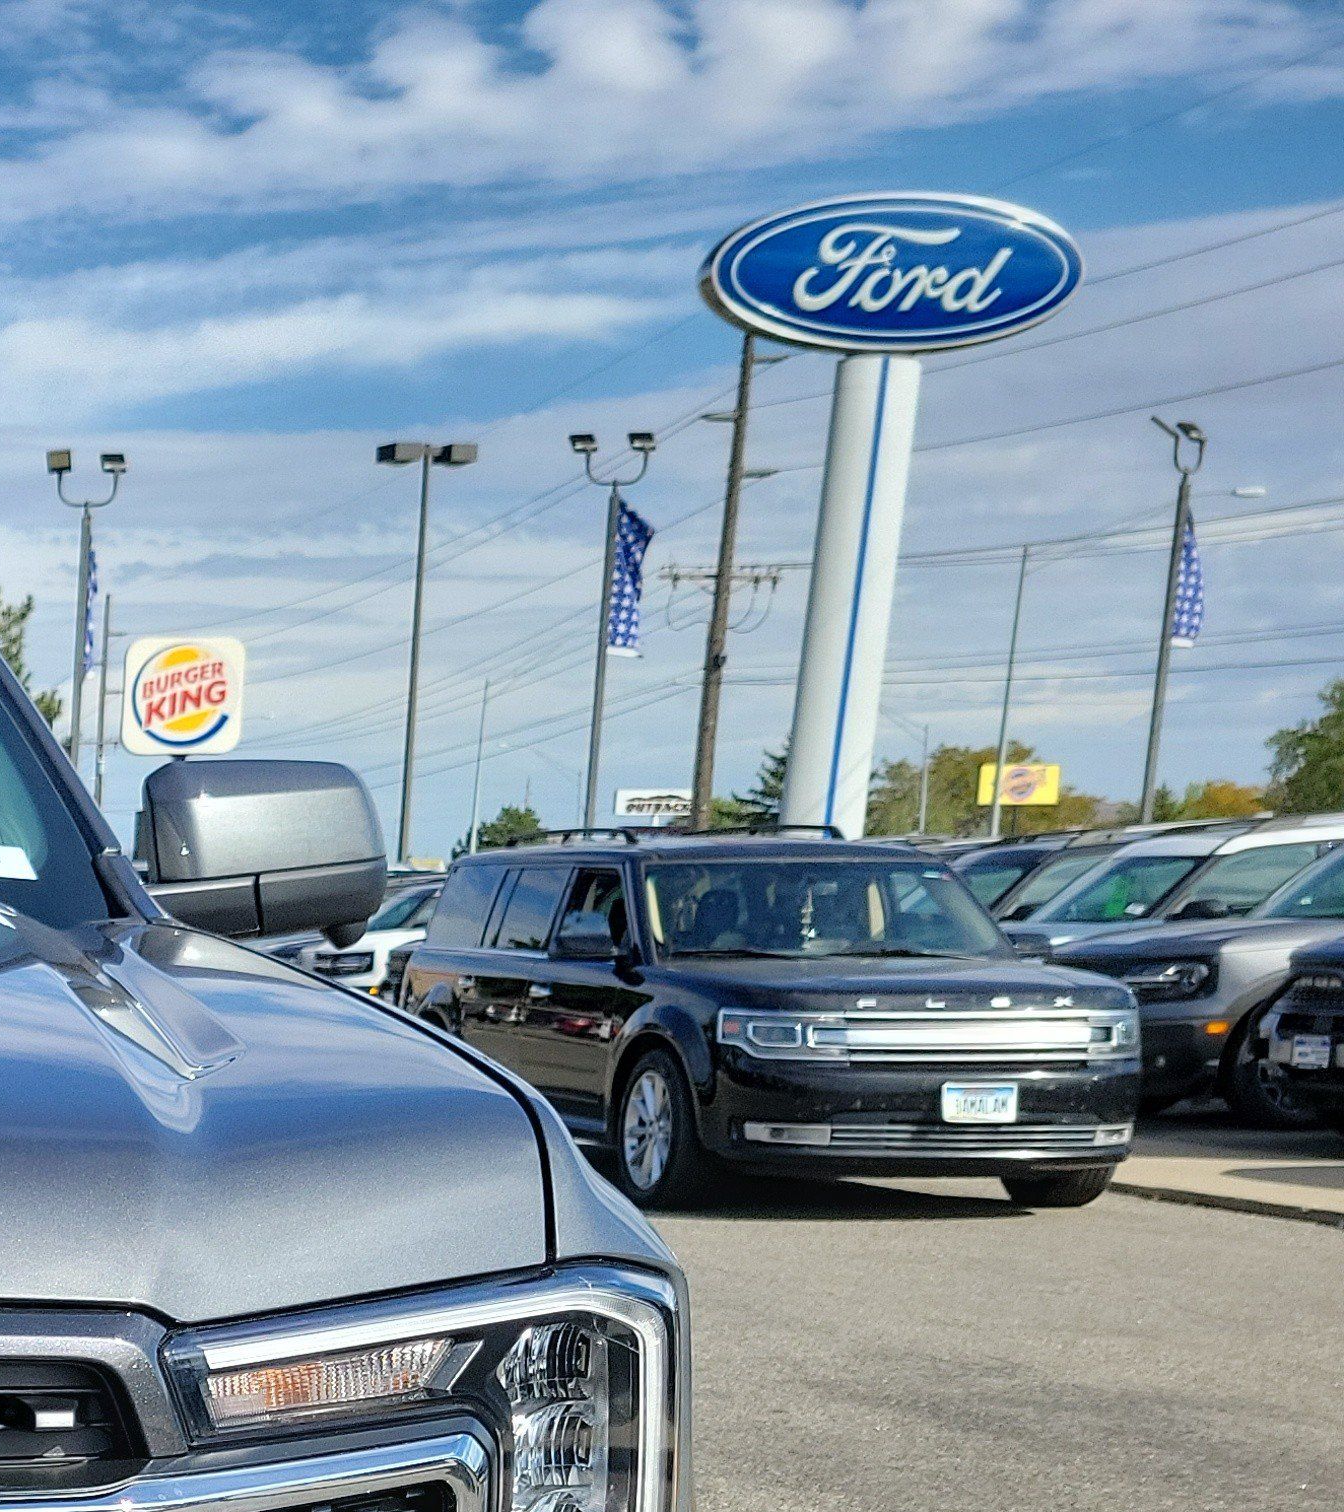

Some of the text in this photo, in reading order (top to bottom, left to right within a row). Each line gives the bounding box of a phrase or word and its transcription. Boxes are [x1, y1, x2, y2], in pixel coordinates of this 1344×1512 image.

[792, 222, 1012, 312] Ford
[142, 661, 225, 699] BURGER
[142, 680, 228, 728] KING
